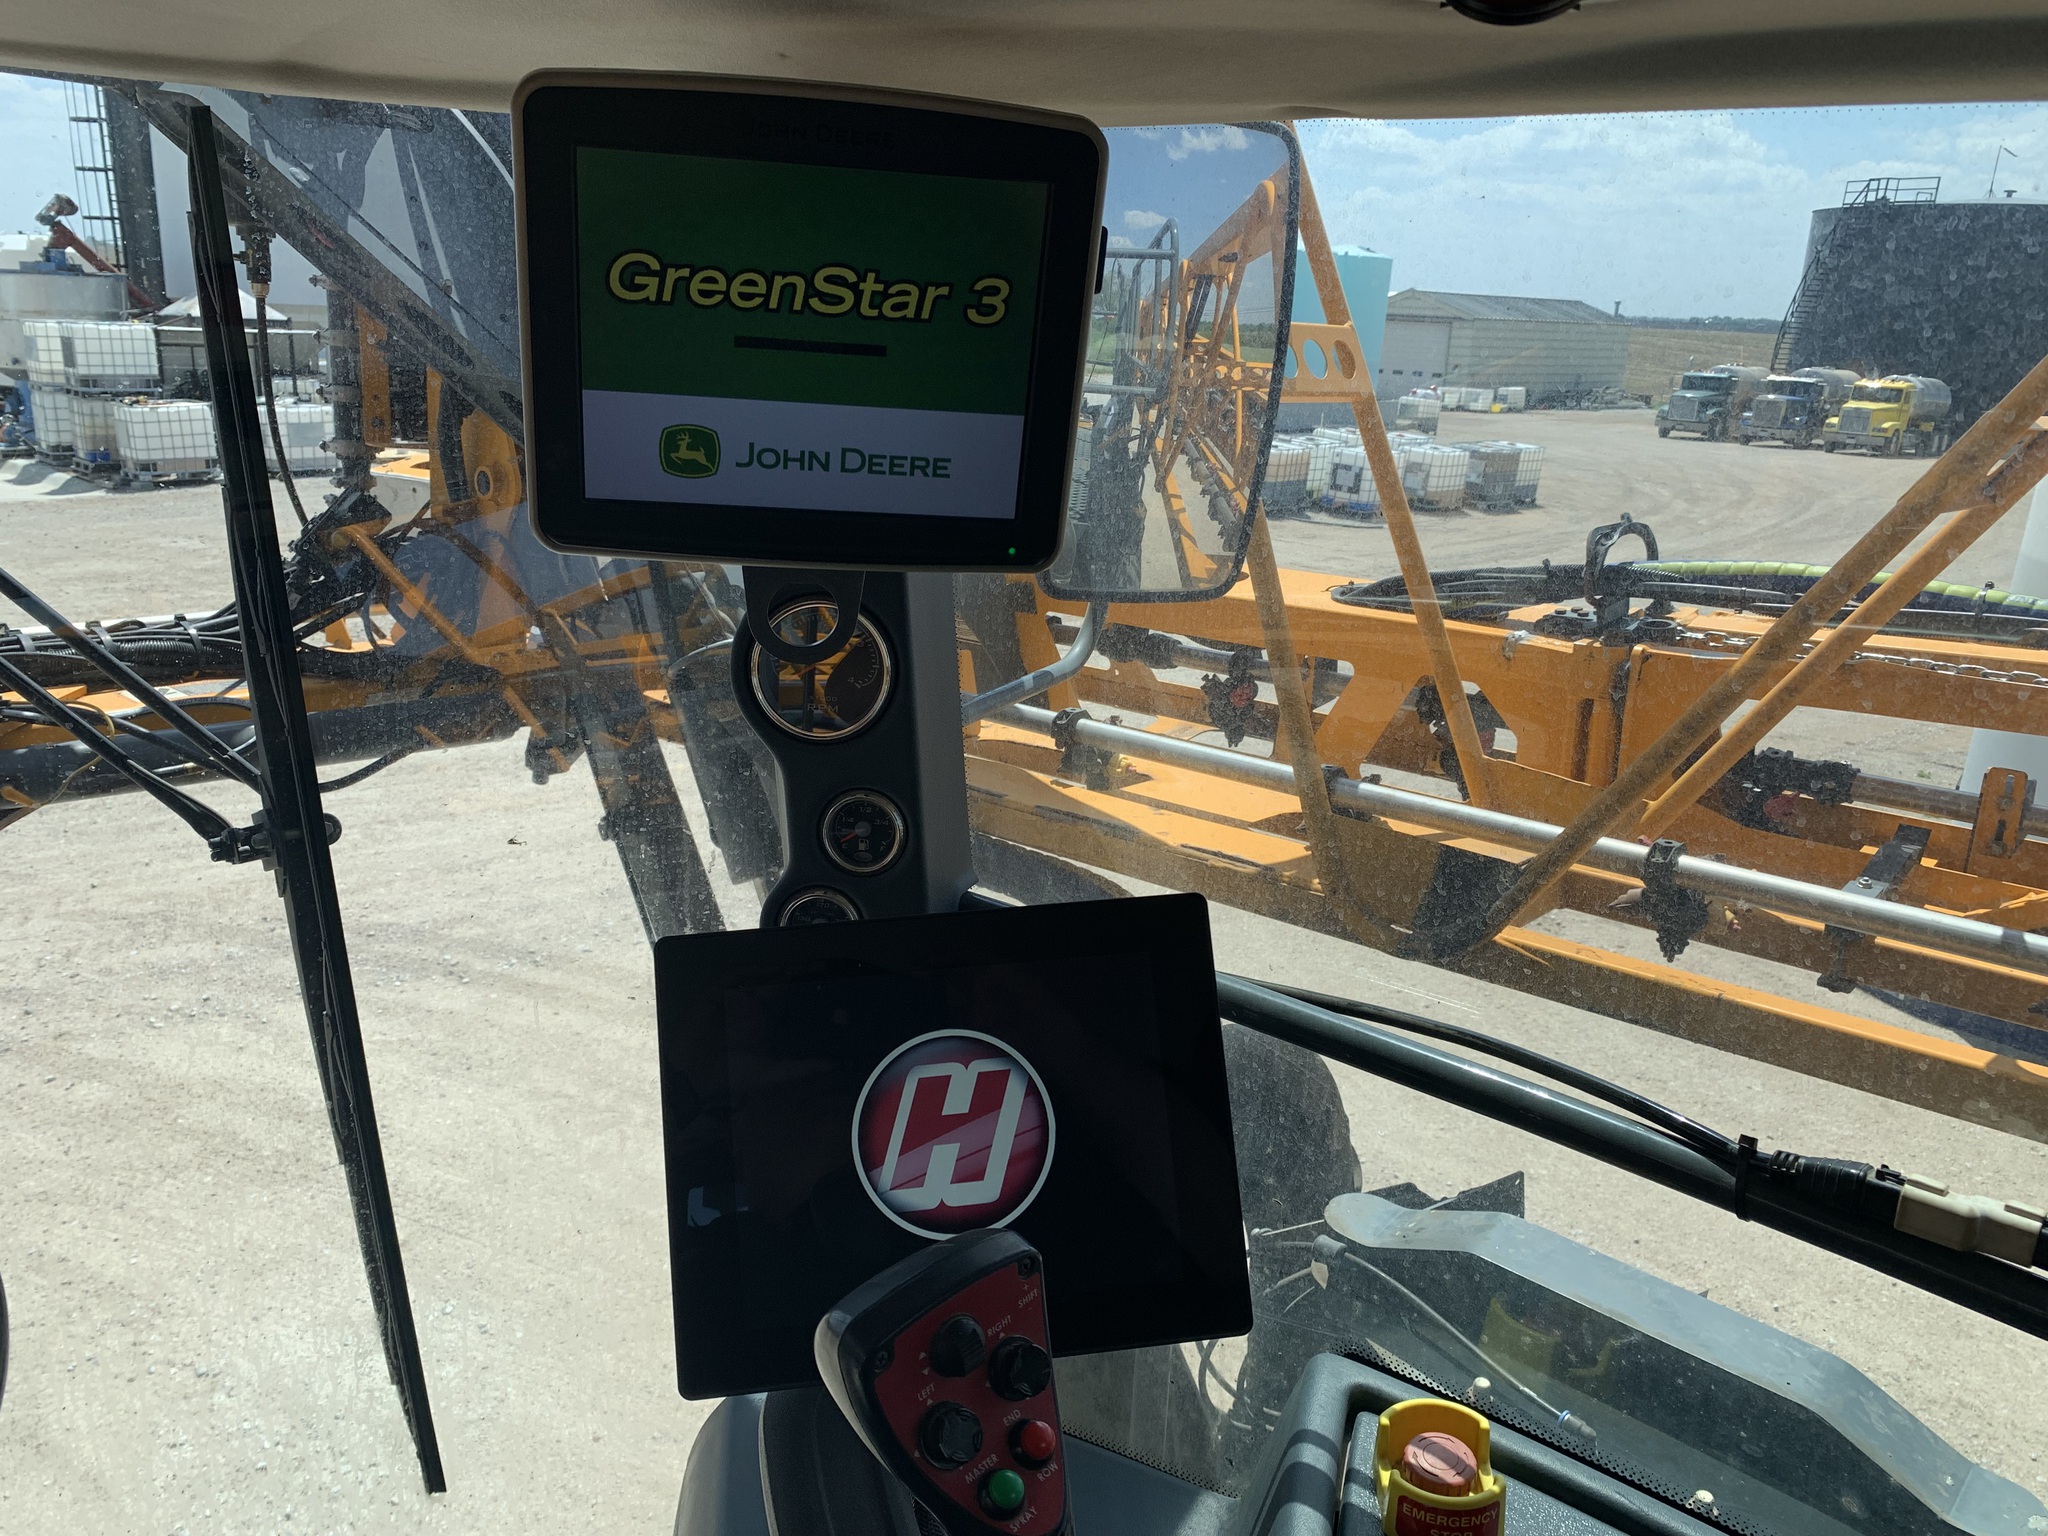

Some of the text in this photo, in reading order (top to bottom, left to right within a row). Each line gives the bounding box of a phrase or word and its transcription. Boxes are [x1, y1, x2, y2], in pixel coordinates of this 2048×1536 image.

[606, 251, 1012, 325] GreenStar 3
[735, 442, 952, 479] JOHN DEERE
[807, 704, 839, 713] RPM
[1017, 1288, 1039, 1308] SHIFT
[986, 1314, 1012, 1337] RIGHT
[917, 1383, 936, 1401] LEFT
[1003, 1409, 1022, 1426] END
[964, 1453, 1000, 1484] MASTER
[1036, 1461, 1059, 1482] ROW
[1009, 1506, 1038, 1533] SPRAY
[1402, 1502, 1498, 1528] EMERGENCY
